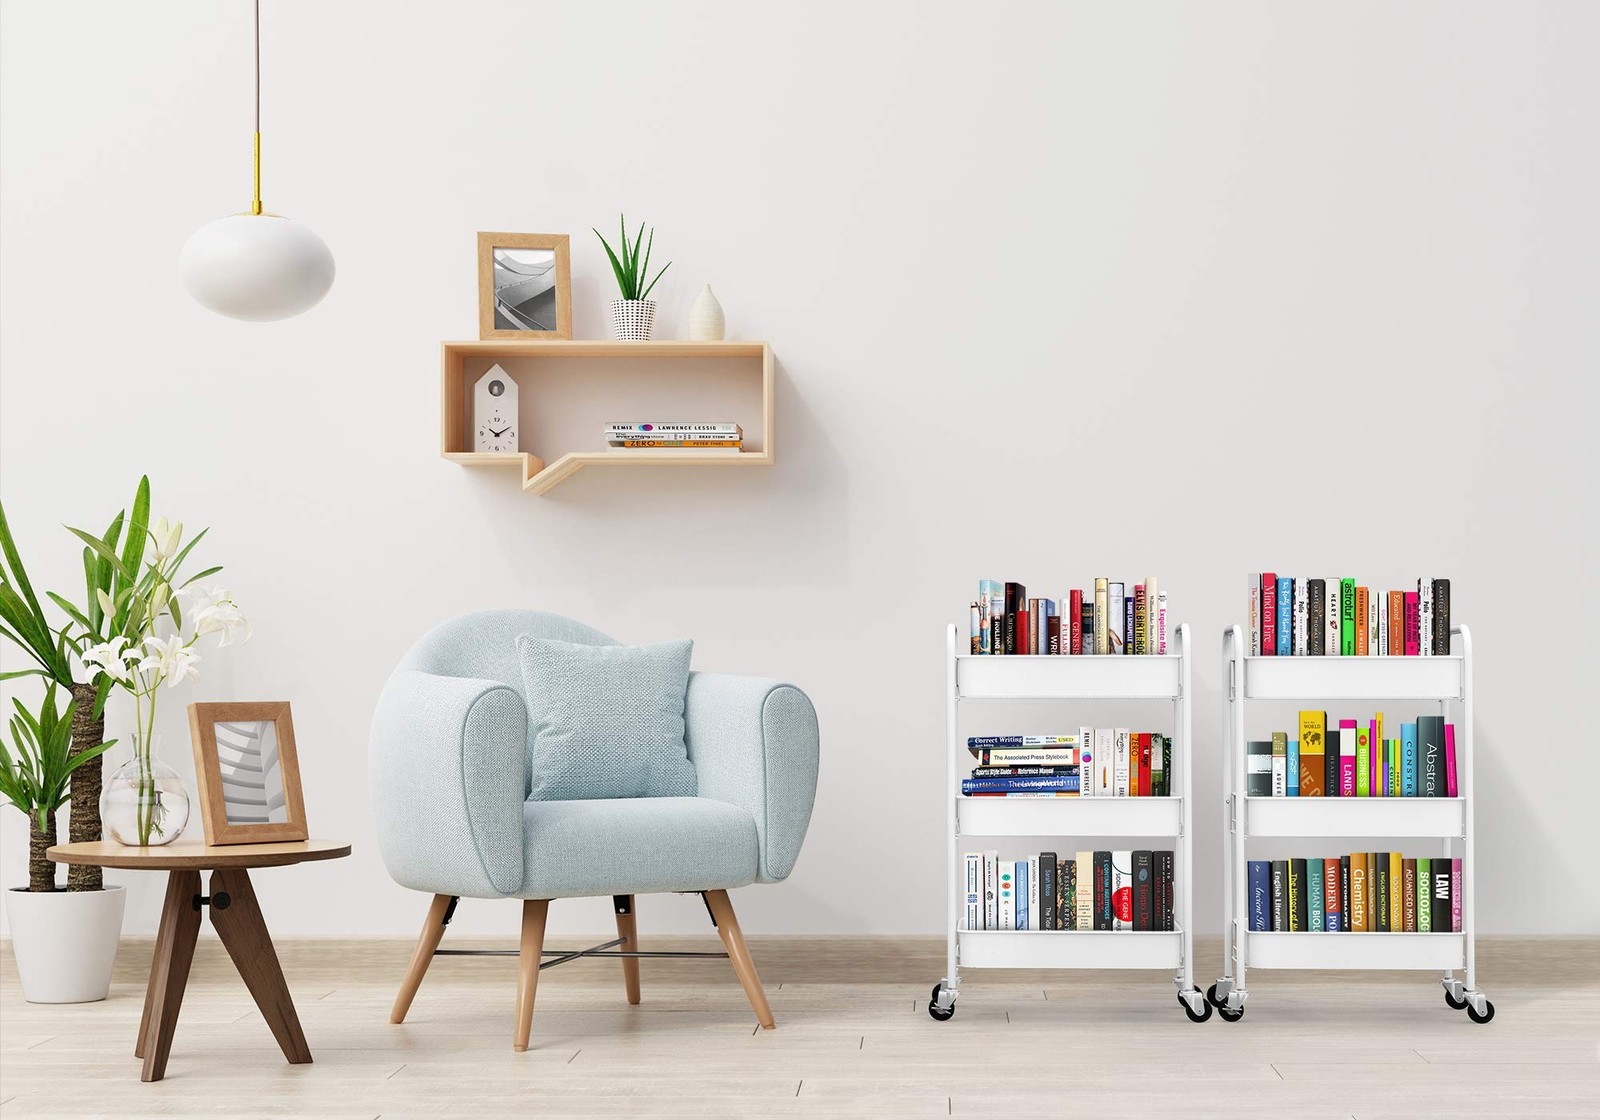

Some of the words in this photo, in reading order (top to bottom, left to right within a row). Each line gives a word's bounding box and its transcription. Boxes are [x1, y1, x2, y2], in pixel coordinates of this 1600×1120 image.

[1136, 590, 1145, 611] ELVIS
[1264, 585, 1274, 609] Mind
[1345, 583, 1354, 621] astroturf
[1393, 595, 1401, 620] Educated
[1136, 615, 1145, 638] BIRTH
[1158, 609, 1166, 640] Exquisite
[1264, 611, 1272, 622] on
[1006, 613, 1015, 651] Caravaggio
[1072, 622, 1080, 655] GENESIS
[1264, 623, 1274, 643] Fire
[1141, 745, 1149, 767] nudge
[1359, 748, 1367, 787] BUSINESS
[1344, 764, 1352, 796] LANDS
[1140, 884, 1148, 910] Homo
[1274, 871, 1282, 897] English
[1312, 873, 1320, 907] HUMAN
[1327, 866, 1336, 909] MODERN
[1436, 874, 1449, 899] LAW
[1255, 881, 1264, 914] Ancient
[1352, 869, 1364, 926] Chemistry
[1291, 914, 1298, 922] of
[1329, 916, 1337, 932] PO
